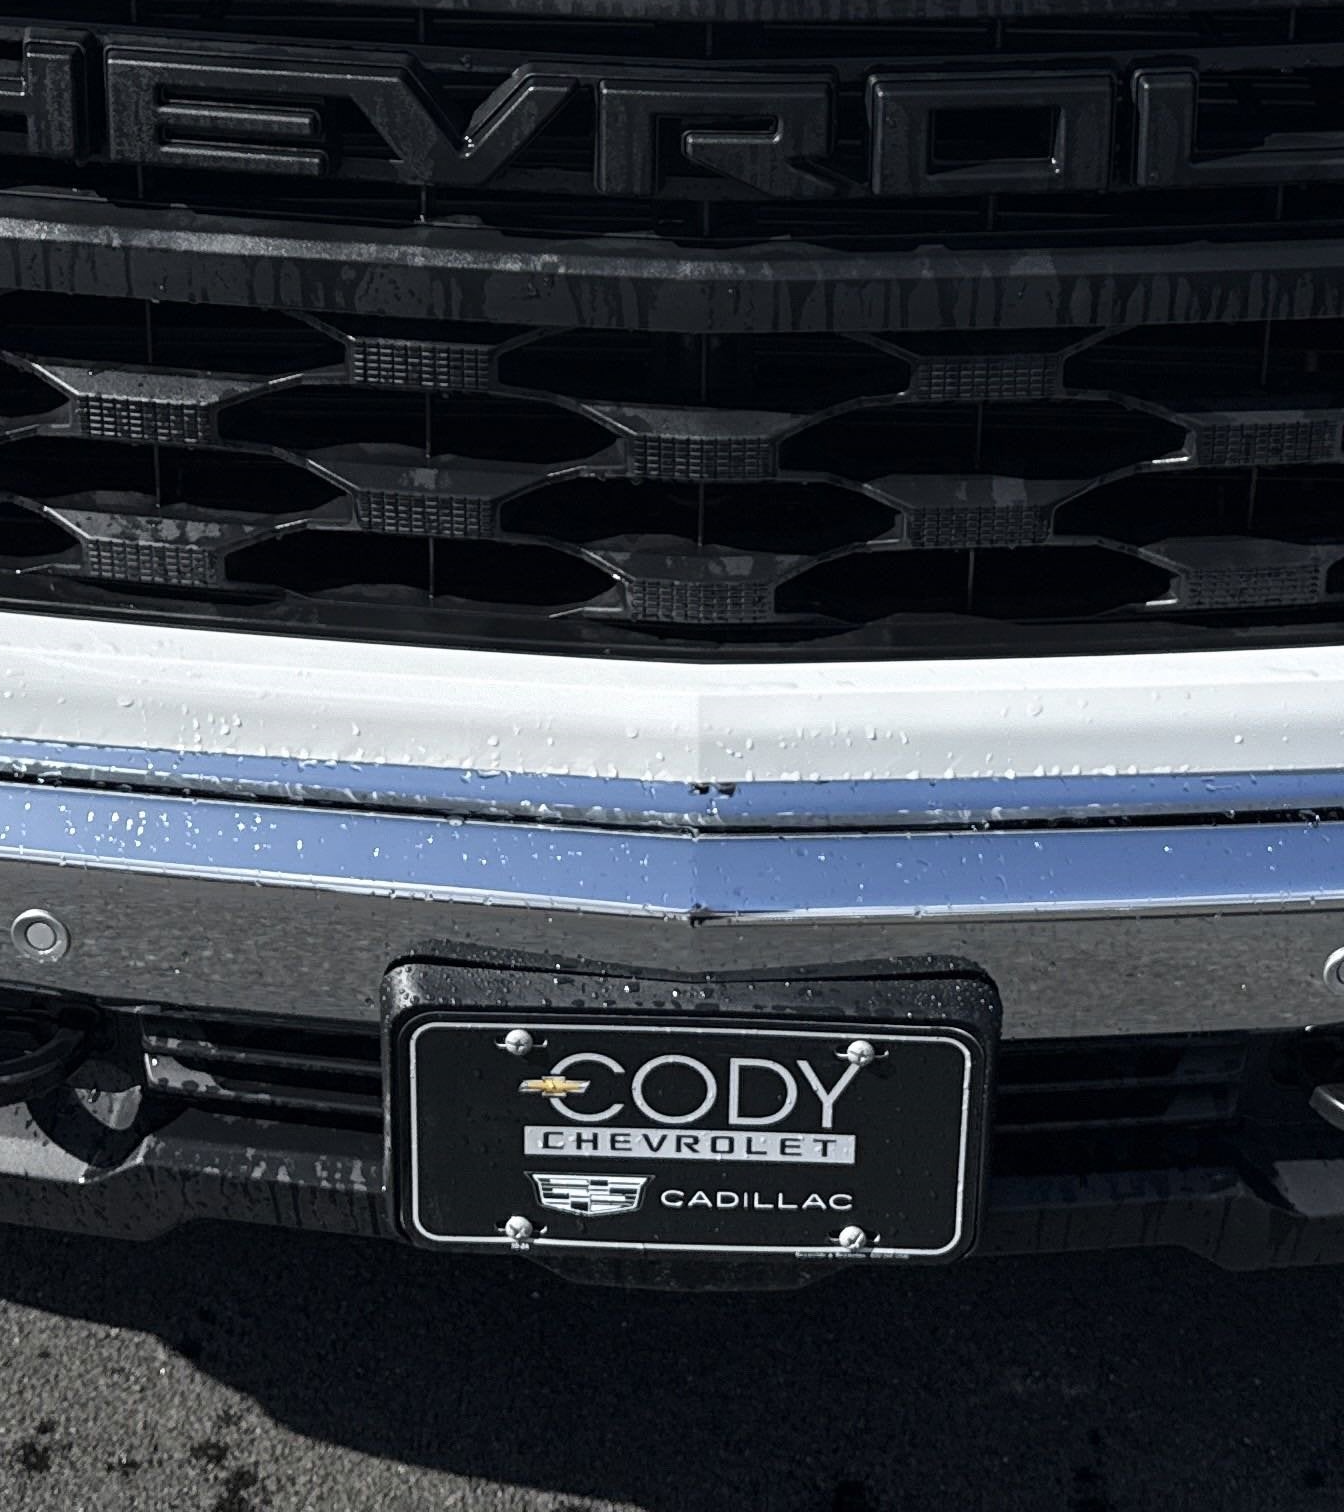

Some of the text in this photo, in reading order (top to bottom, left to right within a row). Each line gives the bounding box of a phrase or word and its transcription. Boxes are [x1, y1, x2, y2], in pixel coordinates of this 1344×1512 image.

[548, 1052, 861, 1129] CODY
[541, 1131, 838, 1158] CHEVROLET
[660, 1189, 854, 1211] CADILLAC
